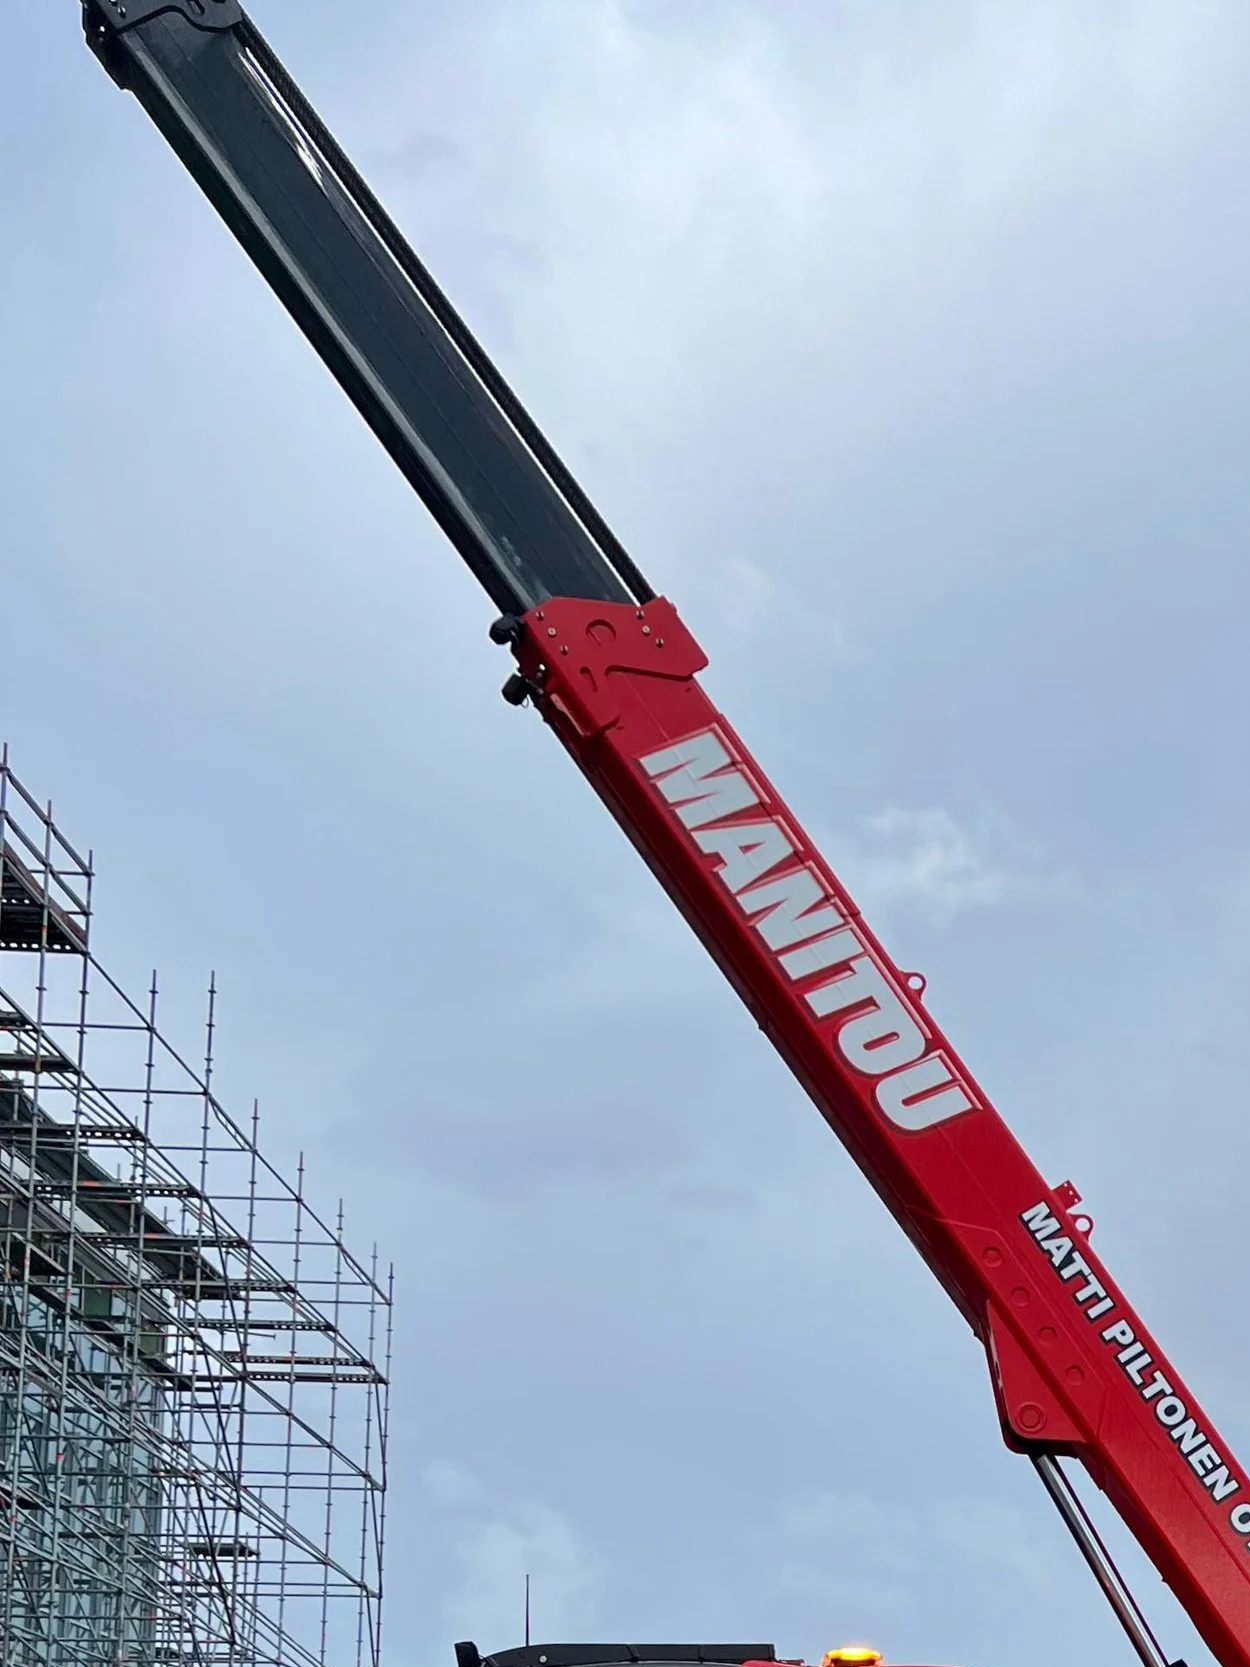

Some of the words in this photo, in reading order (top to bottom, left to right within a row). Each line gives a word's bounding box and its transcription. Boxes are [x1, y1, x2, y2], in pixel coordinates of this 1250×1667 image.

[636, 724, 978, 1131] MANITOU
[1020, 1201, 1115, 1320] MATTI
[1101, 1319, 1239, 1502] PILTONEN
